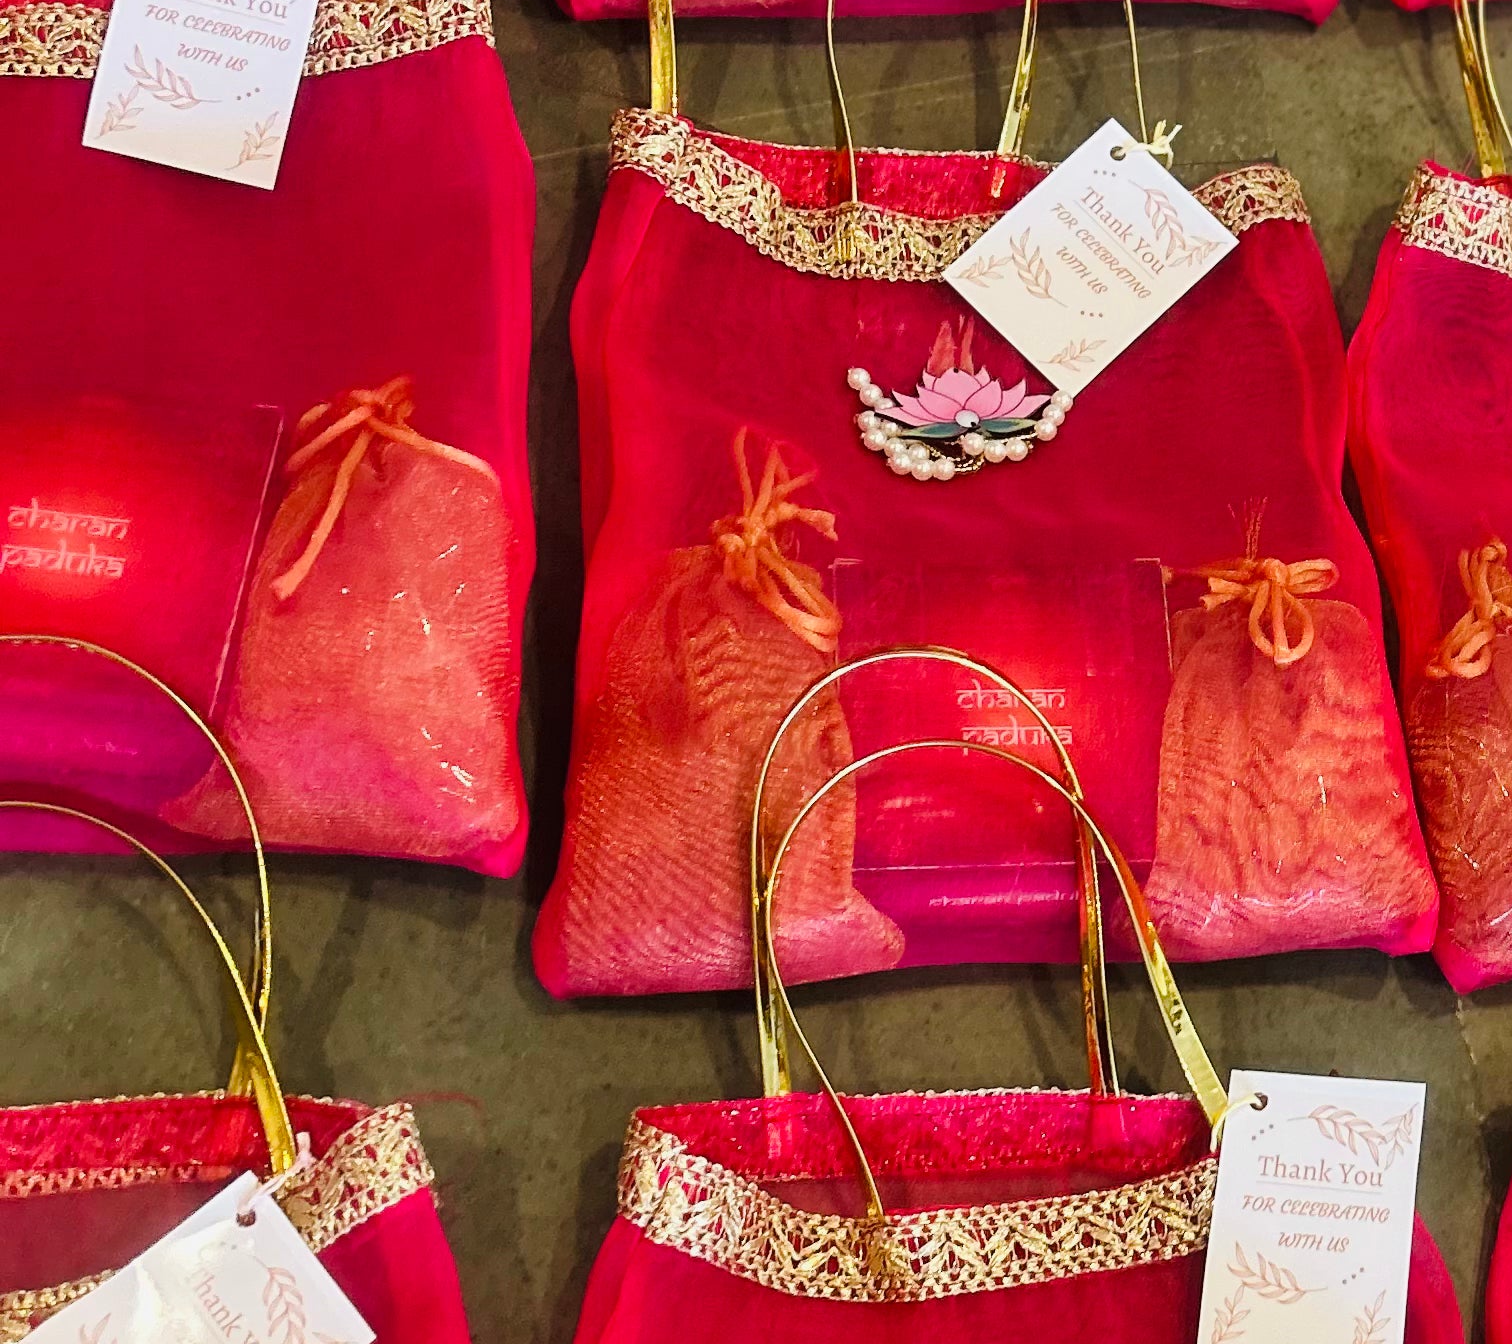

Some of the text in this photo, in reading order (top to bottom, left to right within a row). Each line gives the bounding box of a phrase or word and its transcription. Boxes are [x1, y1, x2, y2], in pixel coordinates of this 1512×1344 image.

[144, 4, 292, 52] FOR CELEBRATING
[176, 43, 248, 72] WITH US
[1049, 202, 1152, 300] FOR CELEBRATING
[1079, 186, 1165, 275] Thank You
[1055, 245, 1109, 296] WITH US
[7, 496, 132, 540] charan
[0, 538, 127, 578] paduka
[1257, 1154, 1385, 1188] Thank You
[1241, 1195, 1391, 1224] FOR CELEBRATING
[1277, 1231, 1350, 1253] WITH US
